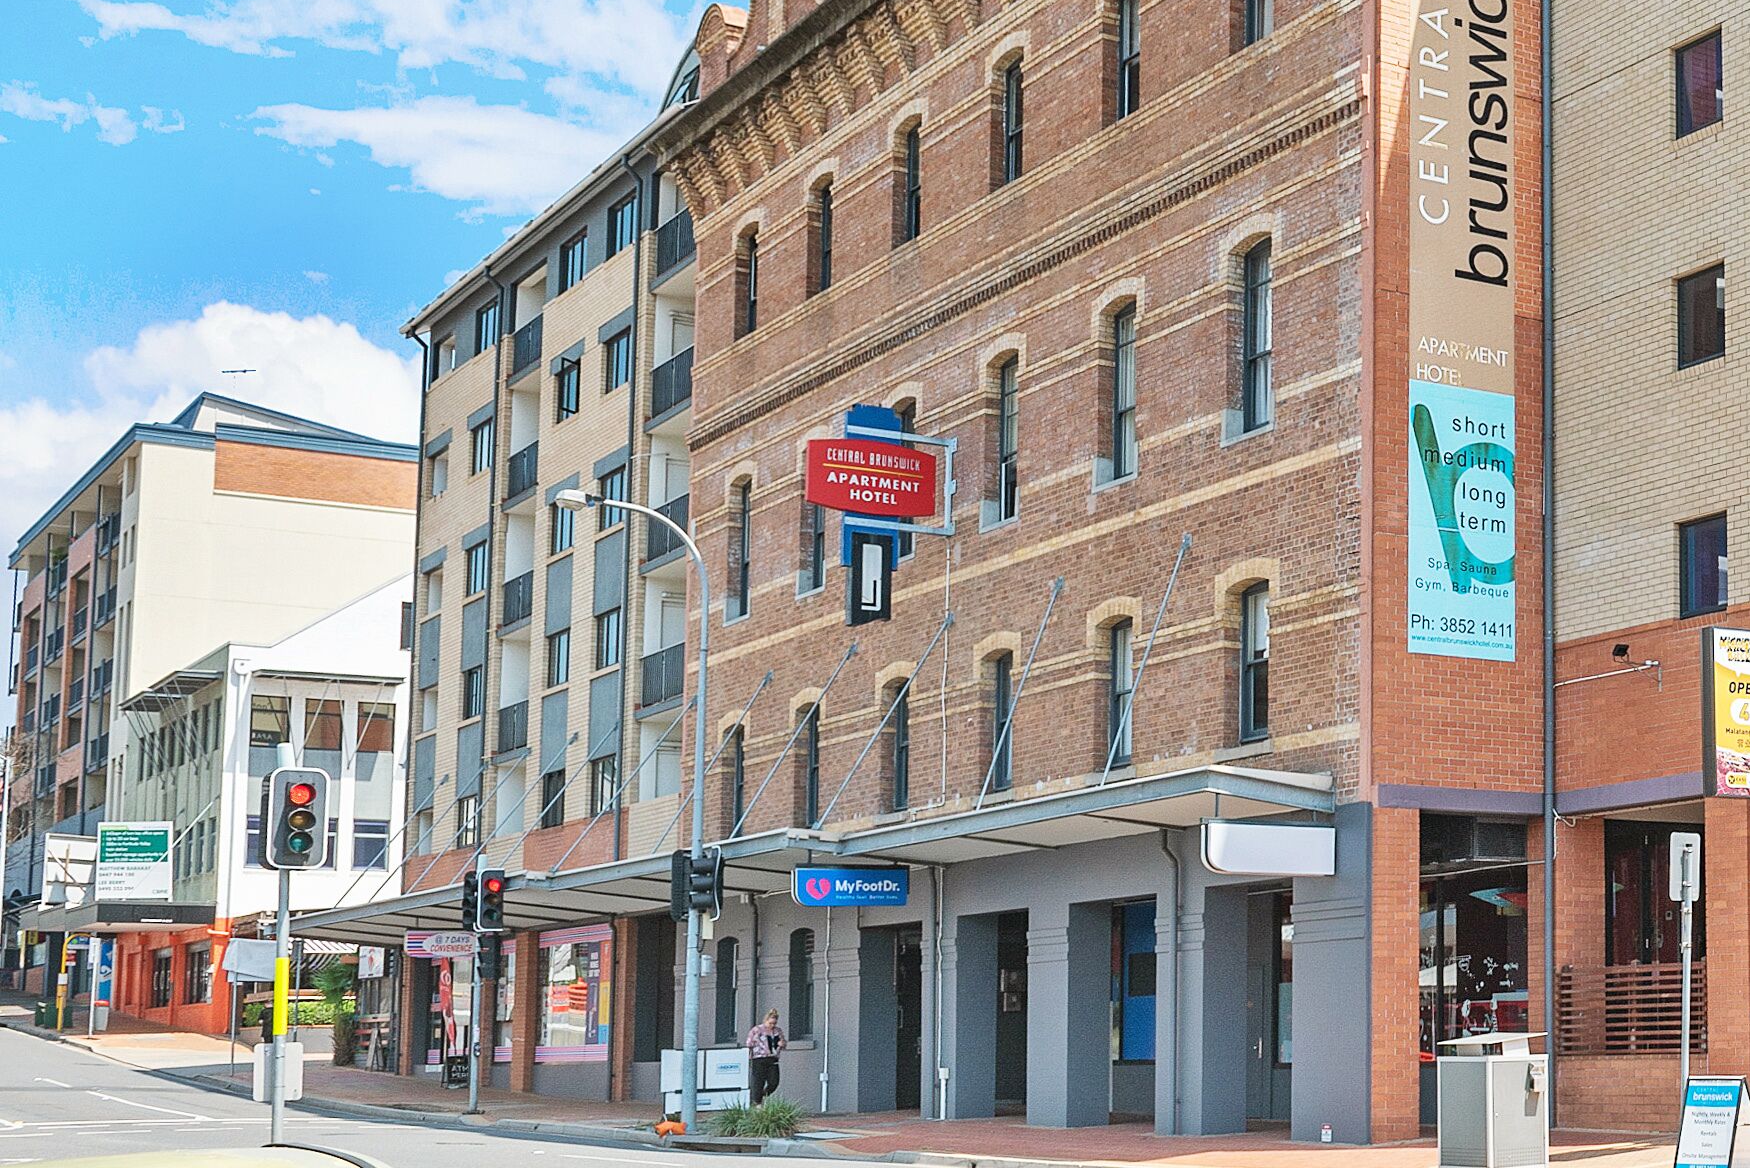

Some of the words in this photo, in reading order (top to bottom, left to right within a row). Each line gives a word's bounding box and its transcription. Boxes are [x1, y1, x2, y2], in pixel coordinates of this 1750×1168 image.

[1417, 336, 1508, 367] APARTMENT
[1452, 416, 1506, 439] short
[827, 448, 866, 466] CENTRAL
[869, 452, 920, 471] BRUNSWICK
[1424, 448, 1506, 473] medium
[827, 472, 920, 492] APARTMENT
[850, 489, 897, 505] HOTEL
[1462, 482, 1506, 509] long
[1460, 512, 1506, 534] term
[1460, 561, 1497, 575] Sauna
[1452, 582, 1509, 598] Barbeque
[1411, 614, 1435, 630] Ph:
[1440, 616, 1475, 634] 3852
[1482, 621, 1512, 638] 1411
[1739, 702, 1750, 721] 4
[1726, 728, 1750, 736] Malatang
[835, 880, 900, 894] MyFootDr.
[431, 944, 472, 952] CONVENIENCE
[1693, 1091, 1733, 1101] brunswick
